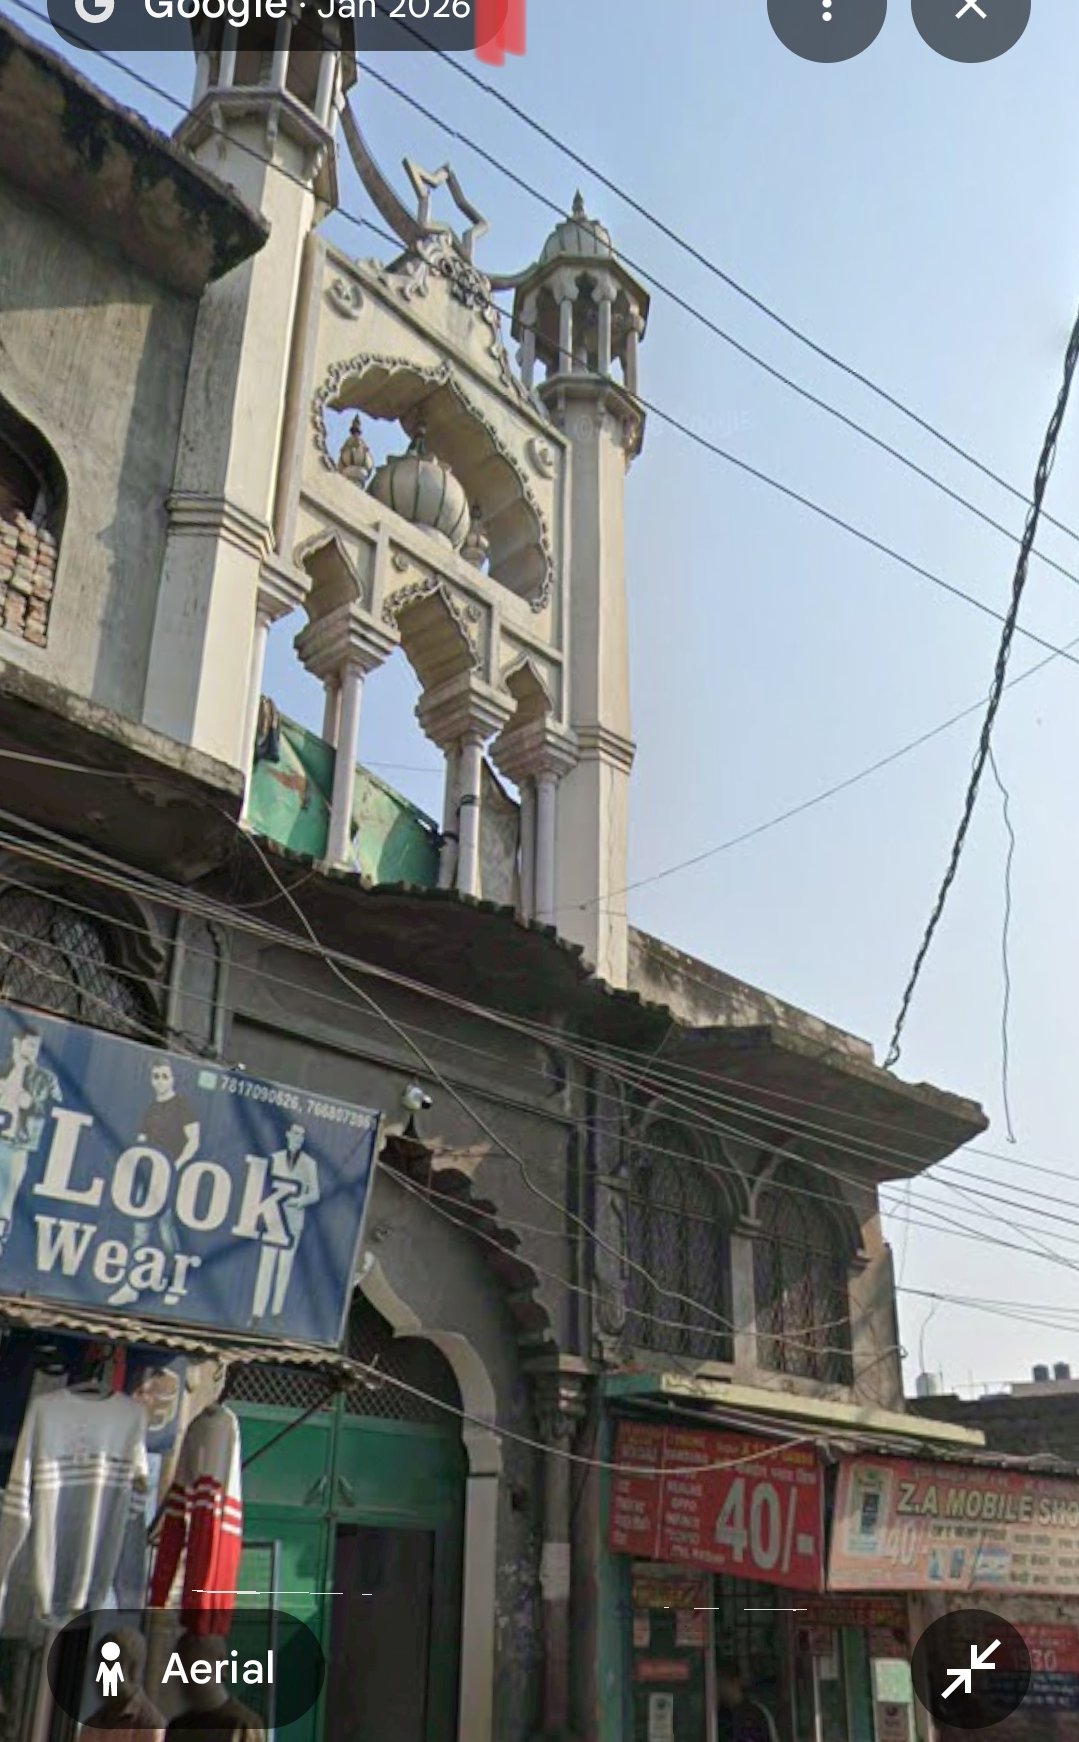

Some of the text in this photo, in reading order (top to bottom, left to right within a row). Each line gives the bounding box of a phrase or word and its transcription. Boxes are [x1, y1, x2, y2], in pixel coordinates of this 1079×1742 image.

[33, 1107, 297, 1246] Look
[34, 1215, 200, 1296] Wear
[714, 1477, 814, 1574] 40/-
[898, 1482, 938, 1515] Z.A
[944, 1487, 1032, 1523] MOBILE
